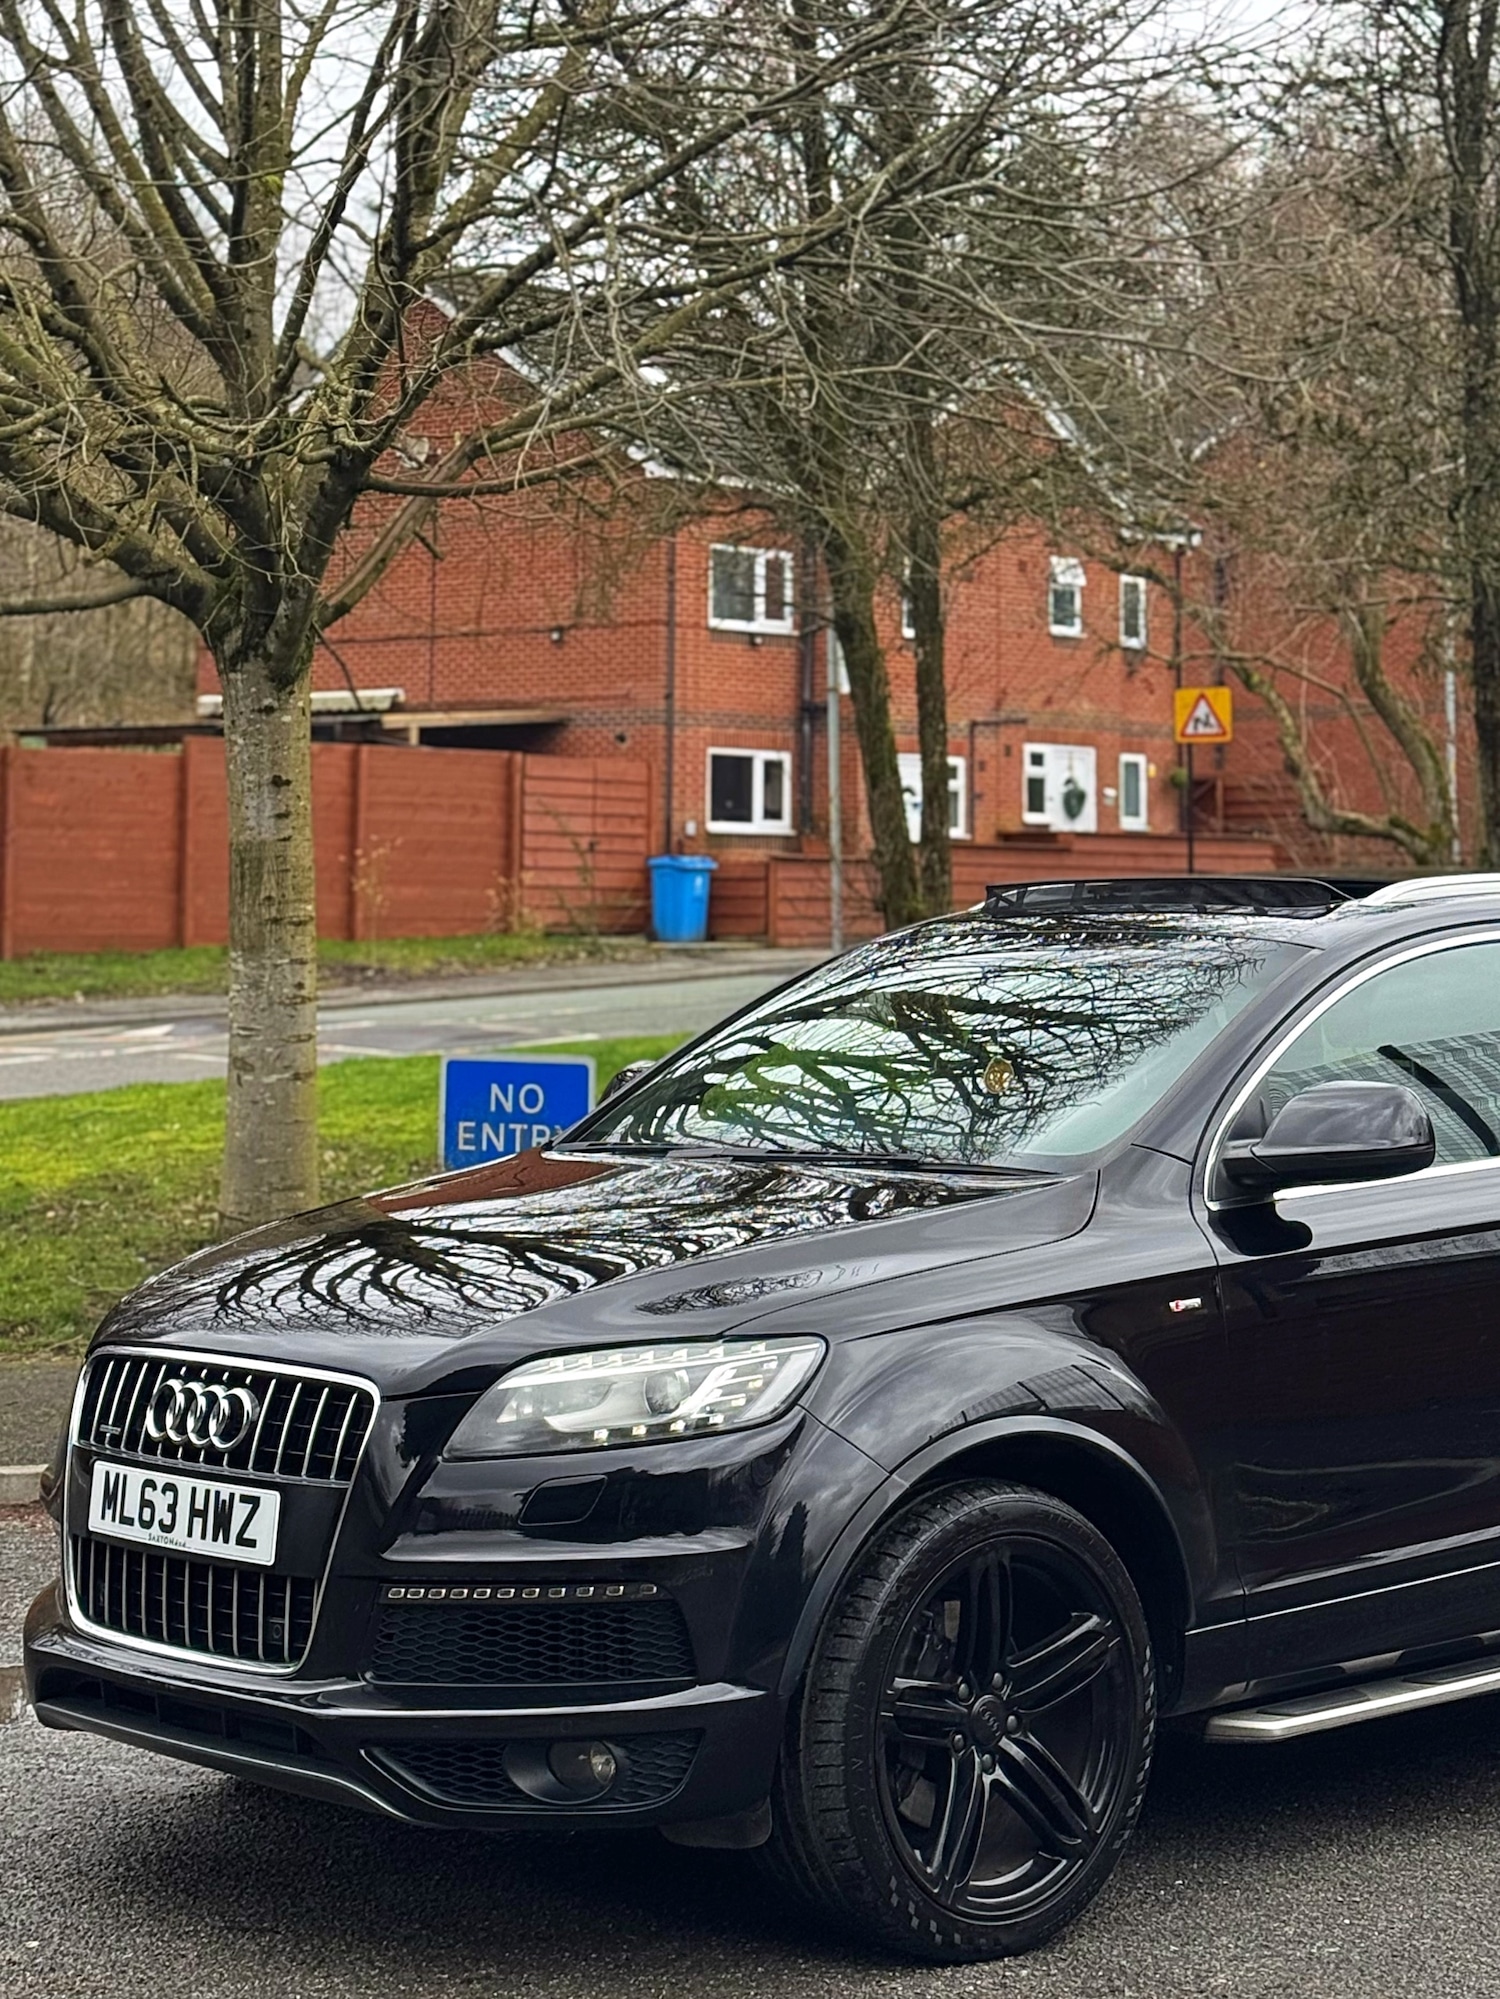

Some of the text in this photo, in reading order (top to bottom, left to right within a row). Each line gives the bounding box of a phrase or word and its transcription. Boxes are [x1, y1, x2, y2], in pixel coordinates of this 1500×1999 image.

[490, 1083, 545, 1114] NO
[100, 1470, 261, 1549] ML63 HWZ
